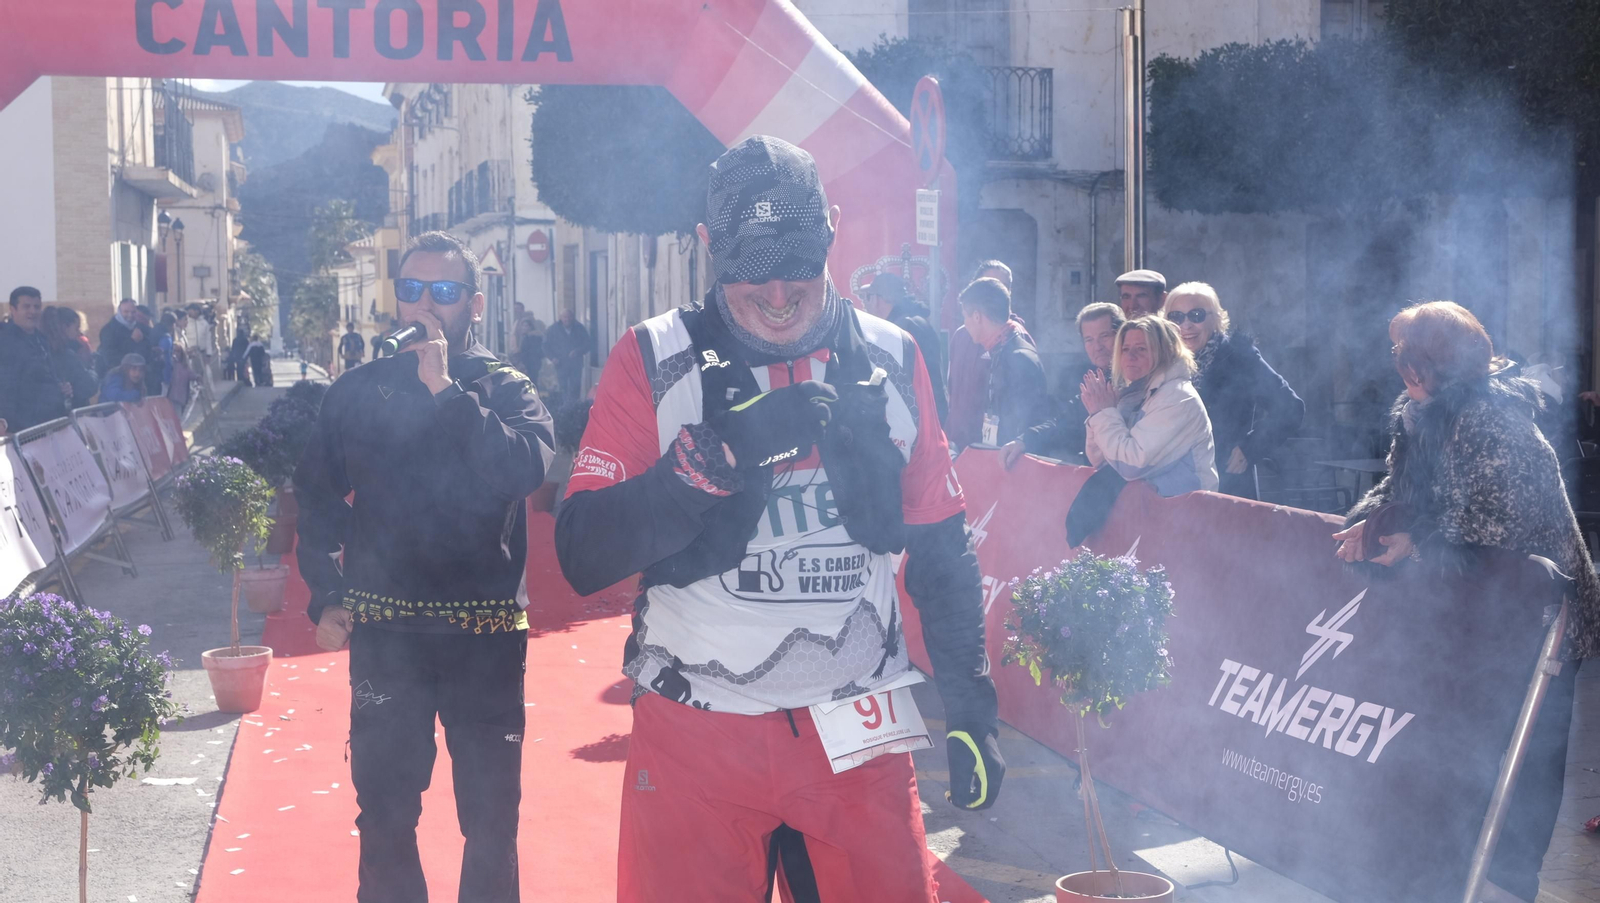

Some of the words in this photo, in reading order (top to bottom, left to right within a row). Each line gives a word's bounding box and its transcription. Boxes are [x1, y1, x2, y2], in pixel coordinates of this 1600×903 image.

[134, 0, 574, 62] CANTORIA
[798, 557, 821, 572] E.S
[825, 552, 866, 572] CABEZO
[798, 571, 865, 594] VENTURA
[853, 690, 897, 730] 97
[1208, 658, 1416, 764] TEAMERGY
[1221, 747, 1324, 804] www.teamergy.es
